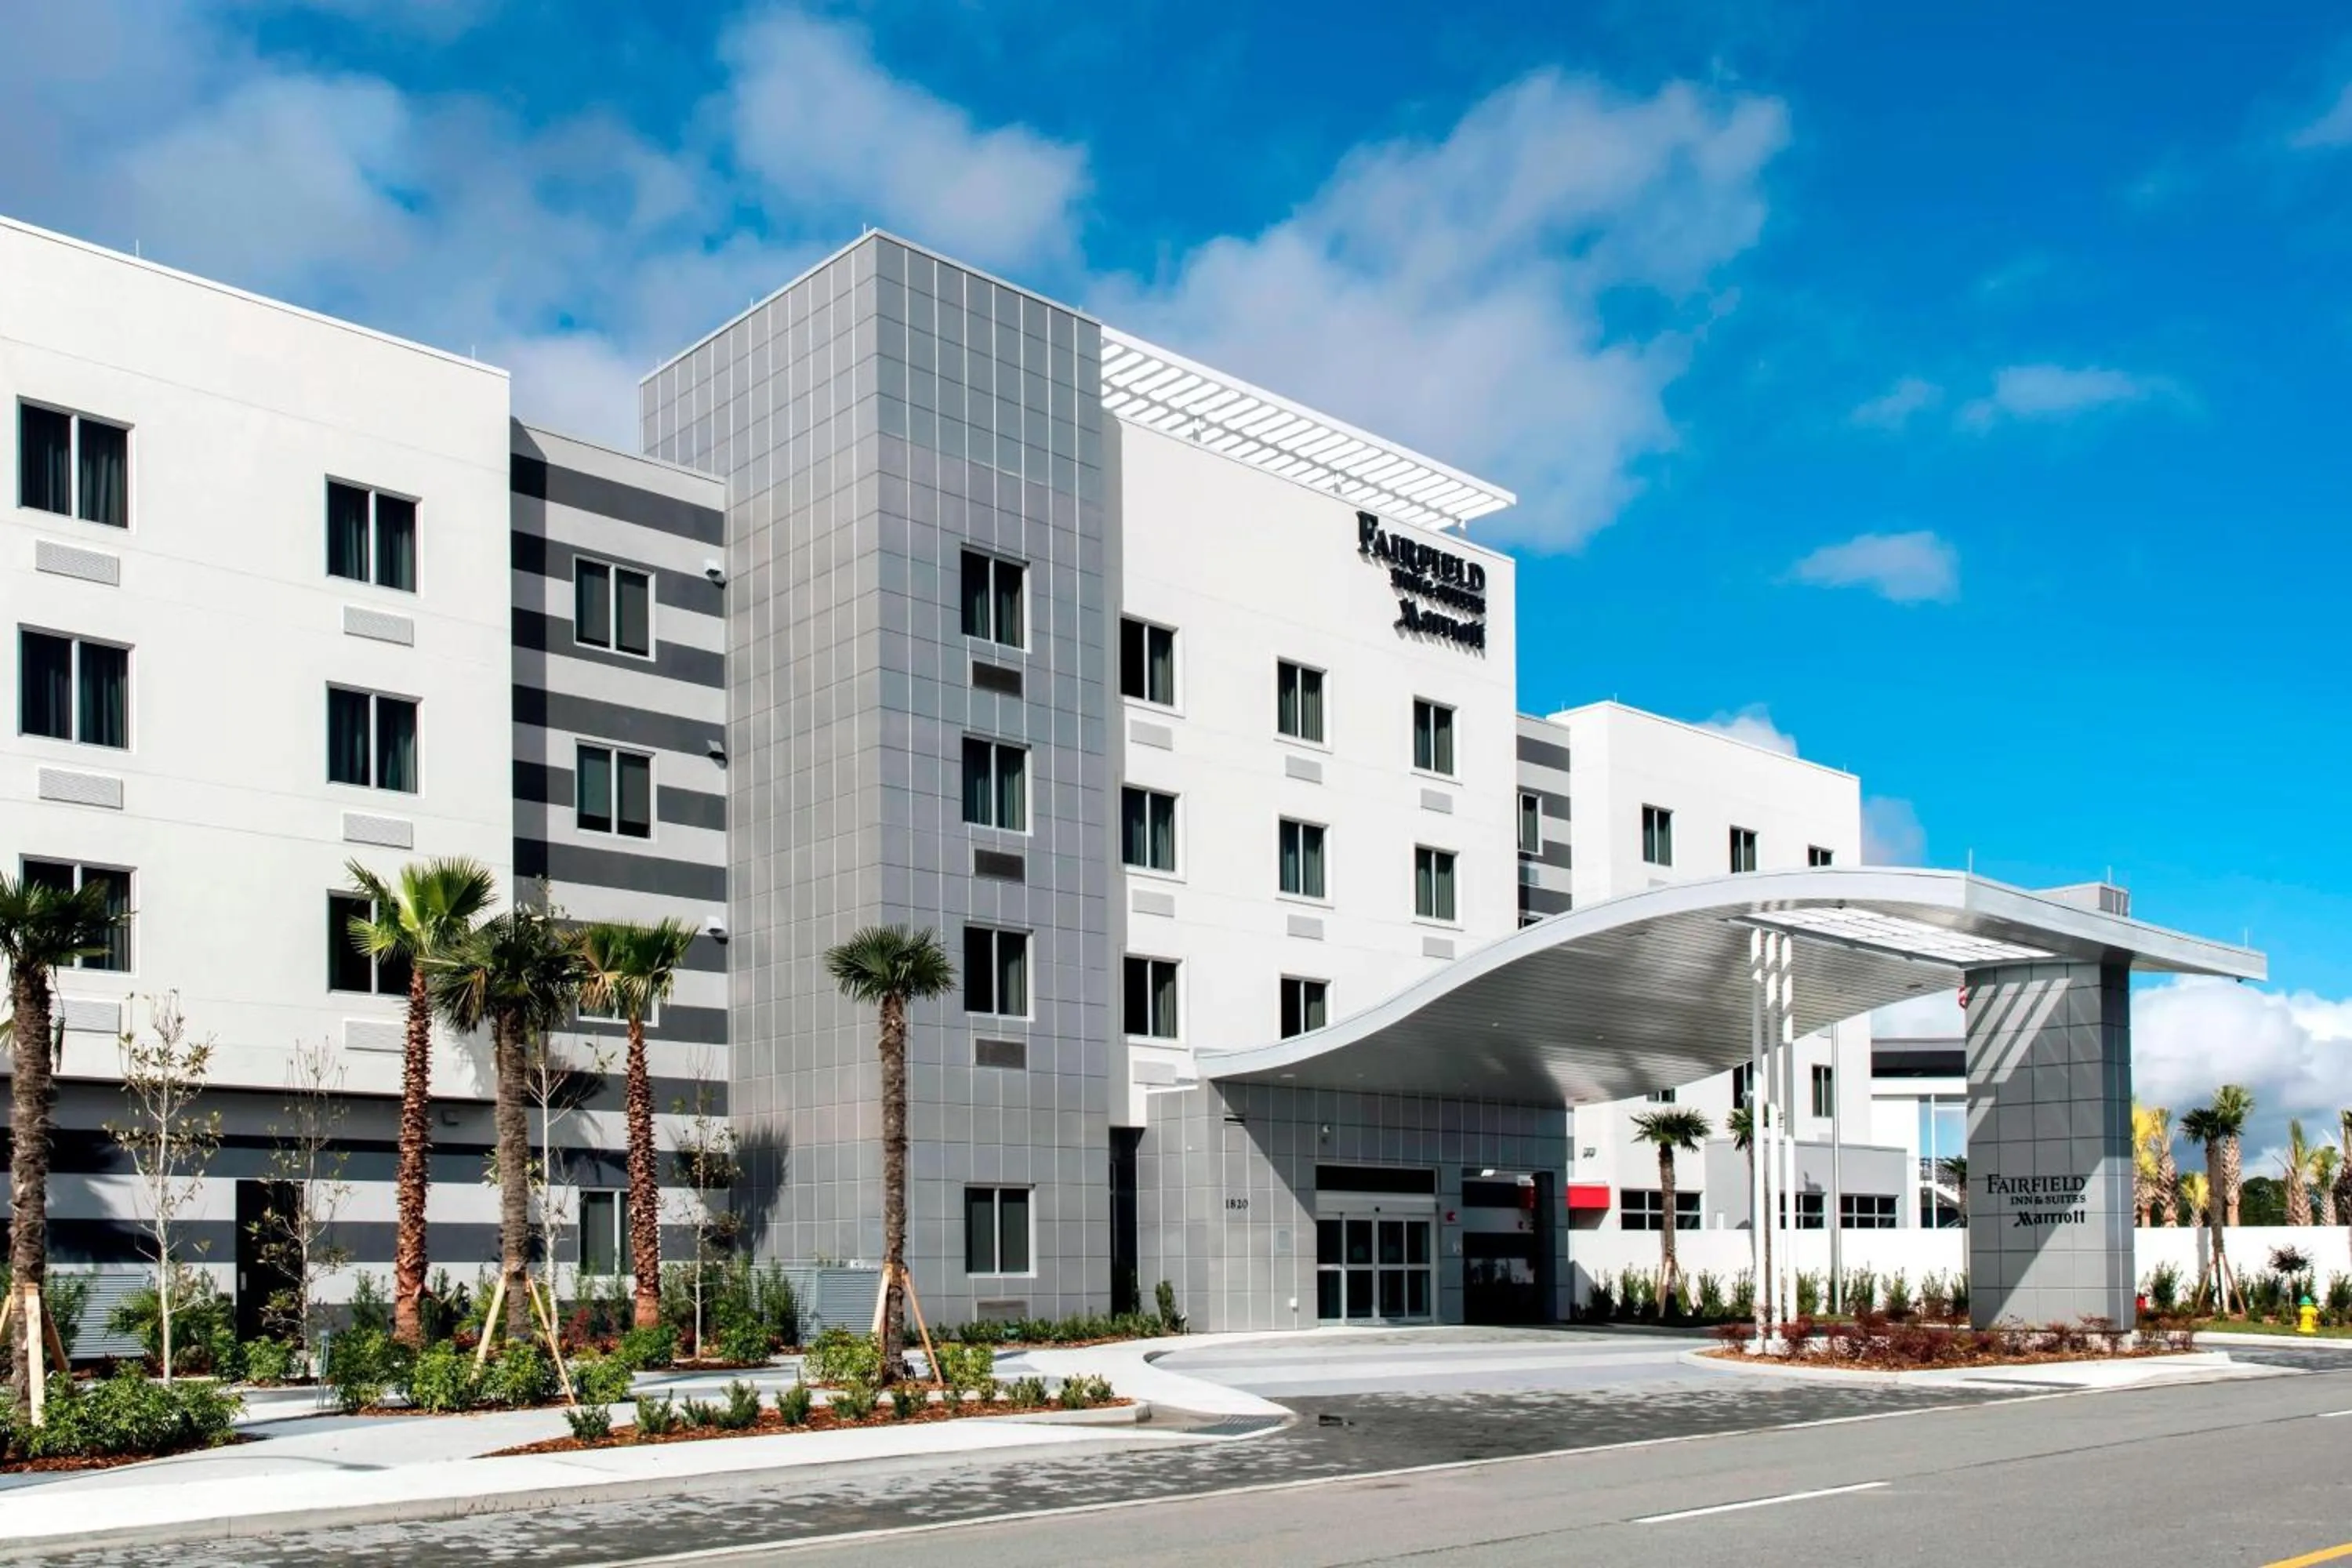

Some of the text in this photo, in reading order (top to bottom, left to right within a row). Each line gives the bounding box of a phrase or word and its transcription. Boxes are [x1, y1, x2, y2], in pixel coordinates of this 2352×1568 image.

[1356, 510, 1485, 591] FAIRFIELD
[1987, 1174, 2085, 1194] FAIRFIELD
[2045, 1194, 2086, 1204] SUITES
[2013, 1210, 2085, 1228] Marriott
